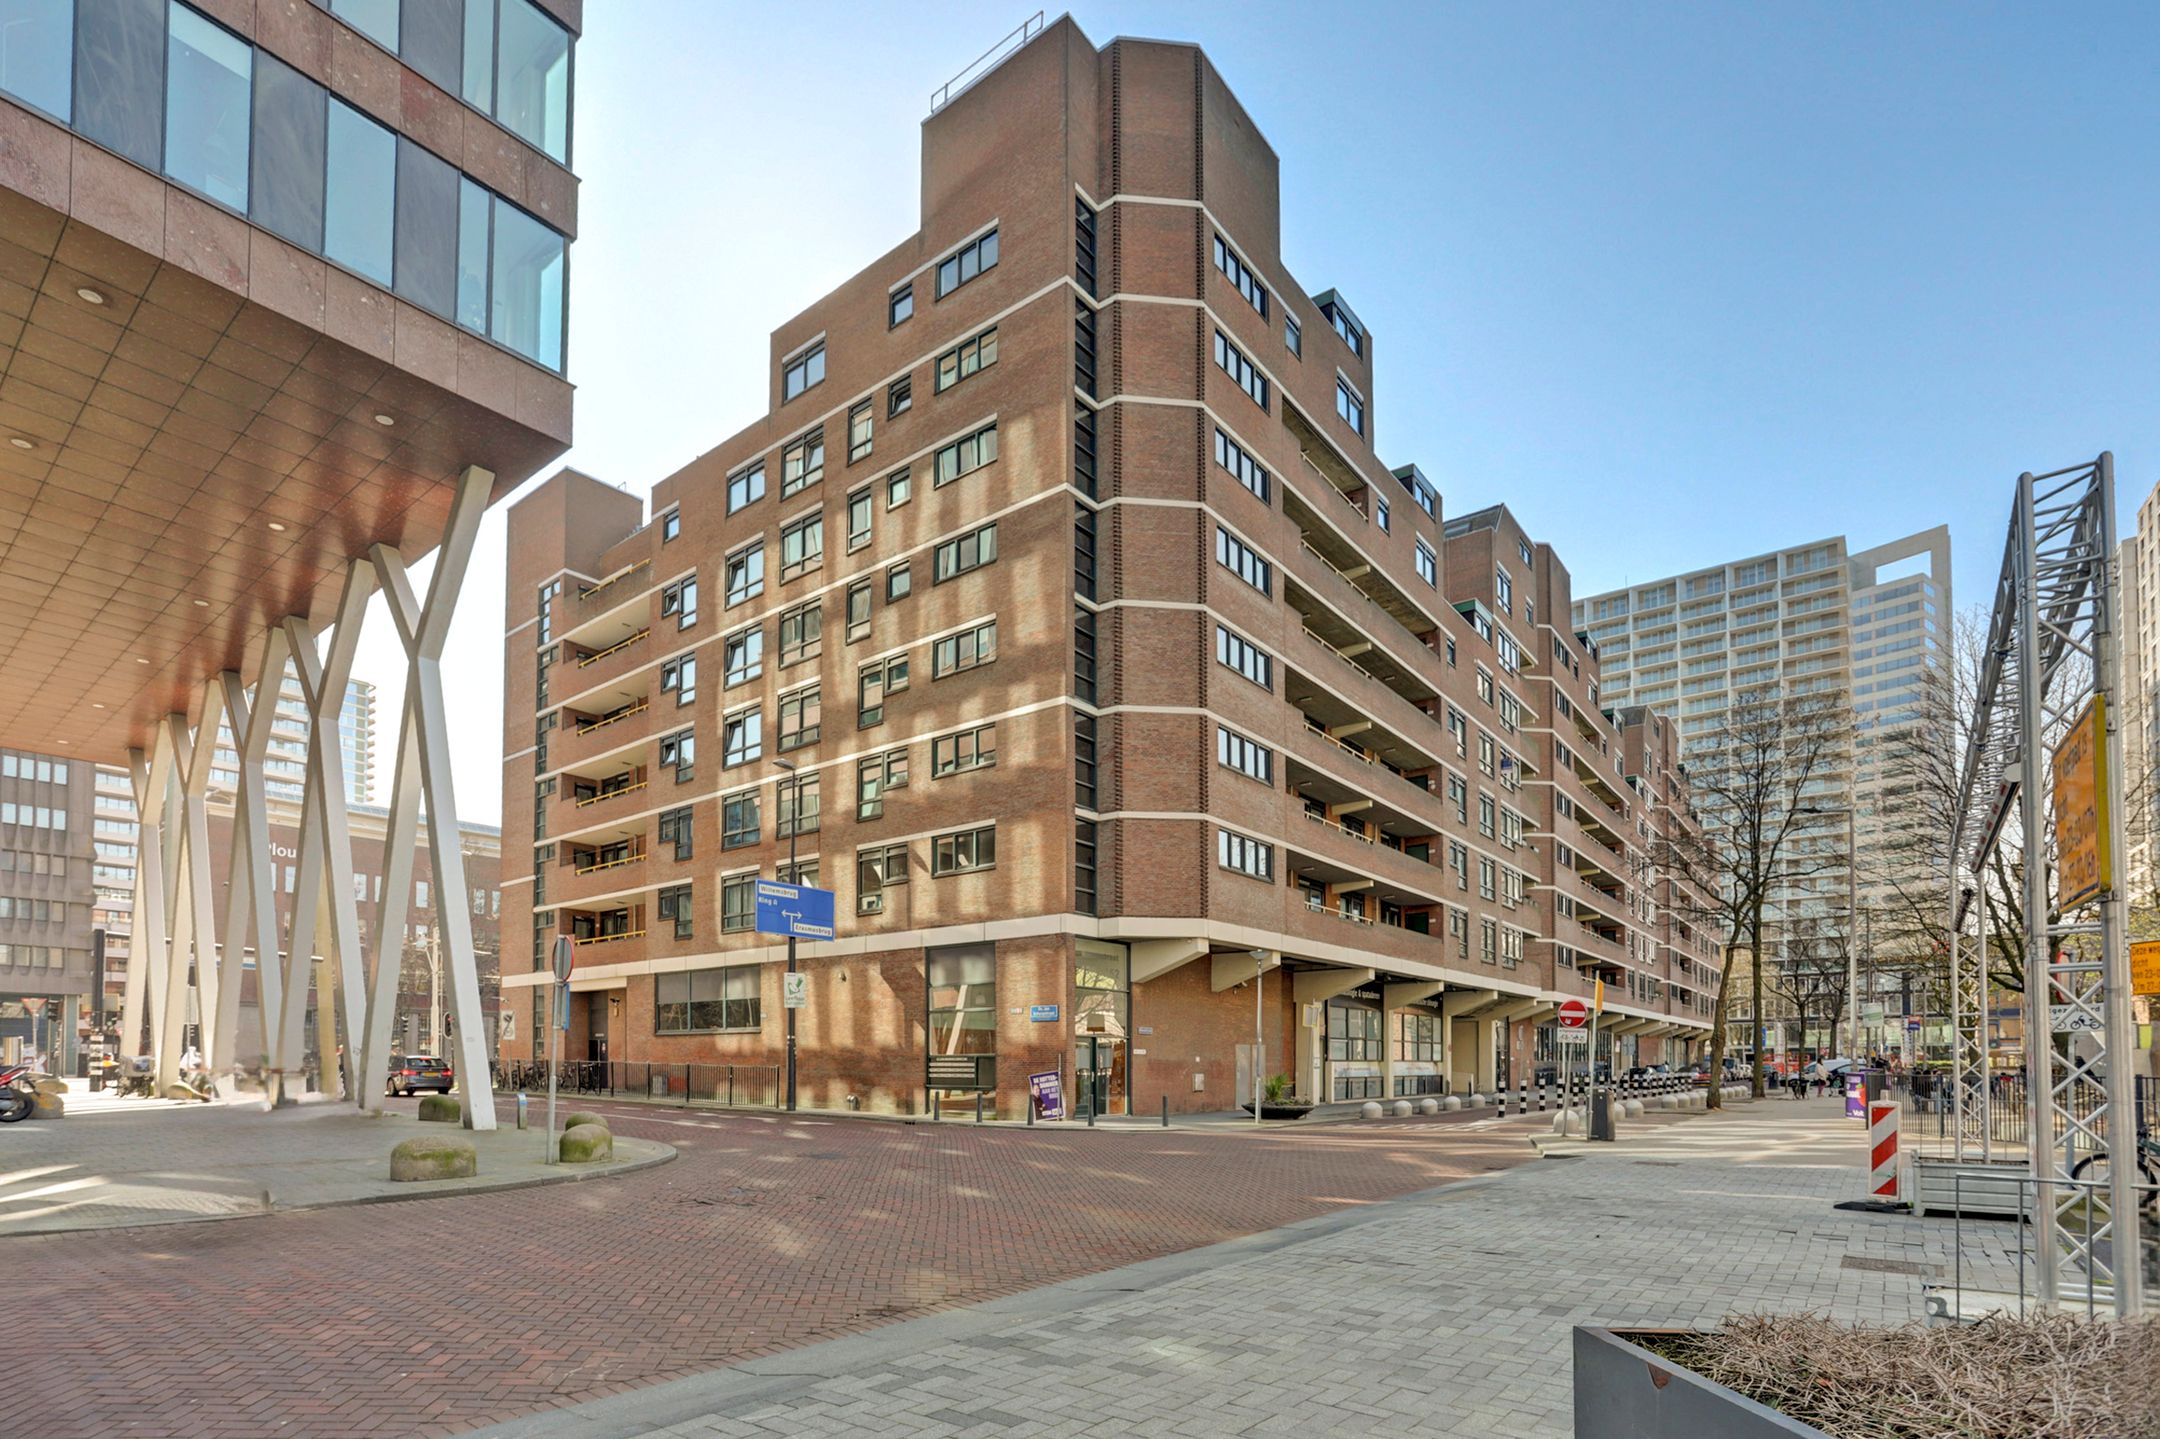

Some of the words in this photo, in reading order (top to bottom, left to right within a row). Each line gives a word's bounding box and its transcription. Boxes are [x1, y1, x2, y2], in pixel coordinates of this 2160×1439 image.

[761, 884, 797, 898] Willemsbrug
[795, 924, 831, 936] Erasmusbrug
[1852, 1109, 1865, 1117] Volt
